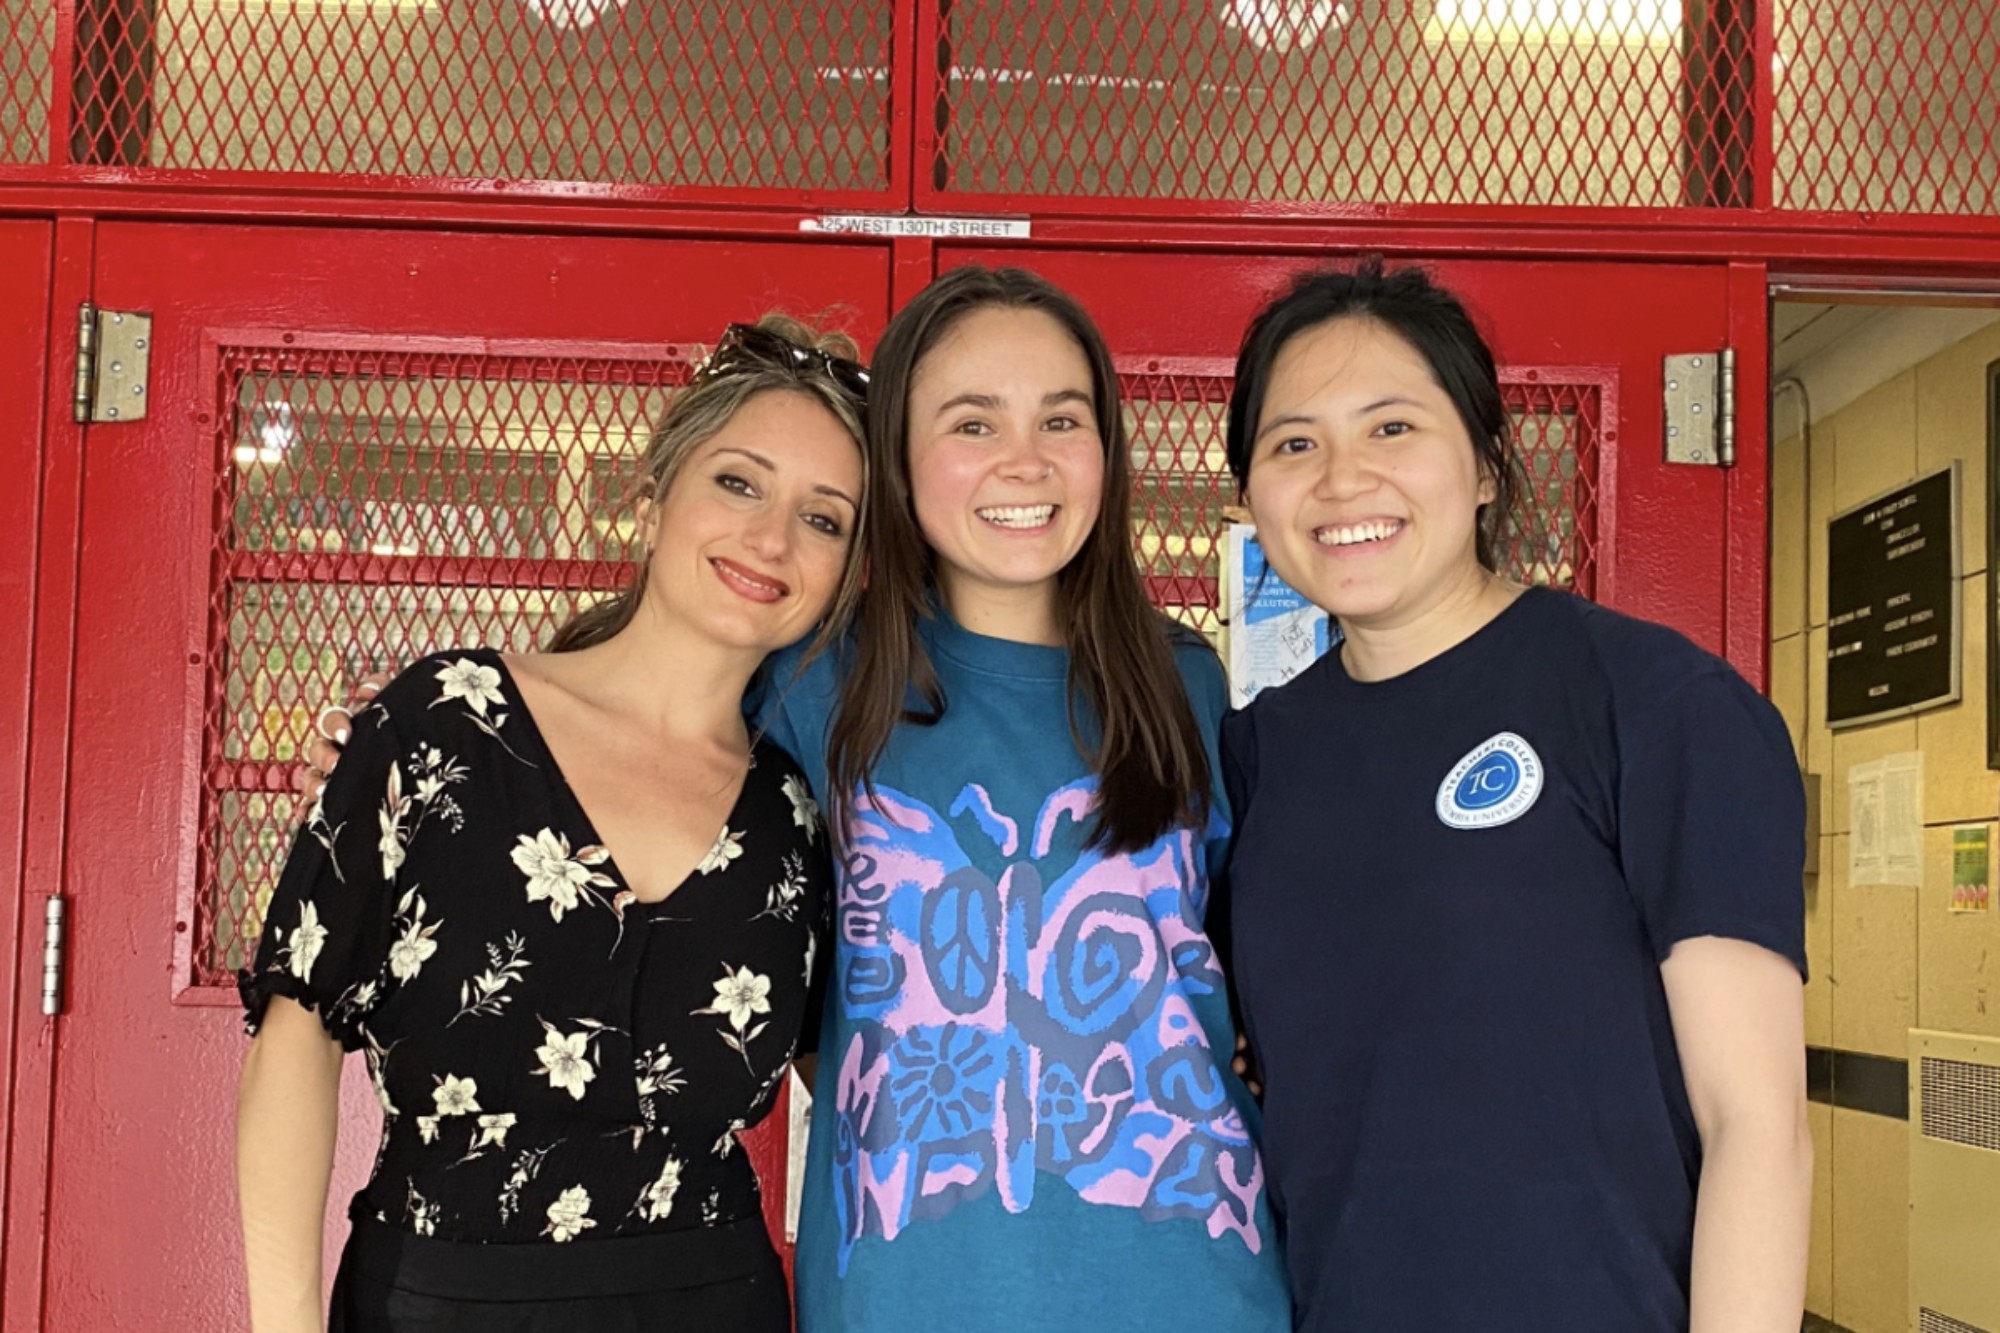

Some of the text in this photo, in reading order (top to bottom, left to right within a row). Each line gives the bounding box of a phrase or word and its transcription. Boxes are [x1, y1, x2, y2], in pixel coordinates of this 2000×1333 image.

[847, 219, 893, 232] WEST
[898, 221, 944, 233] 130TH
[949, 222, 1012, 235] STREET
[1498, 738, 1536, 779] COLLEGE
[1469, 766, 1507, 797] TC
